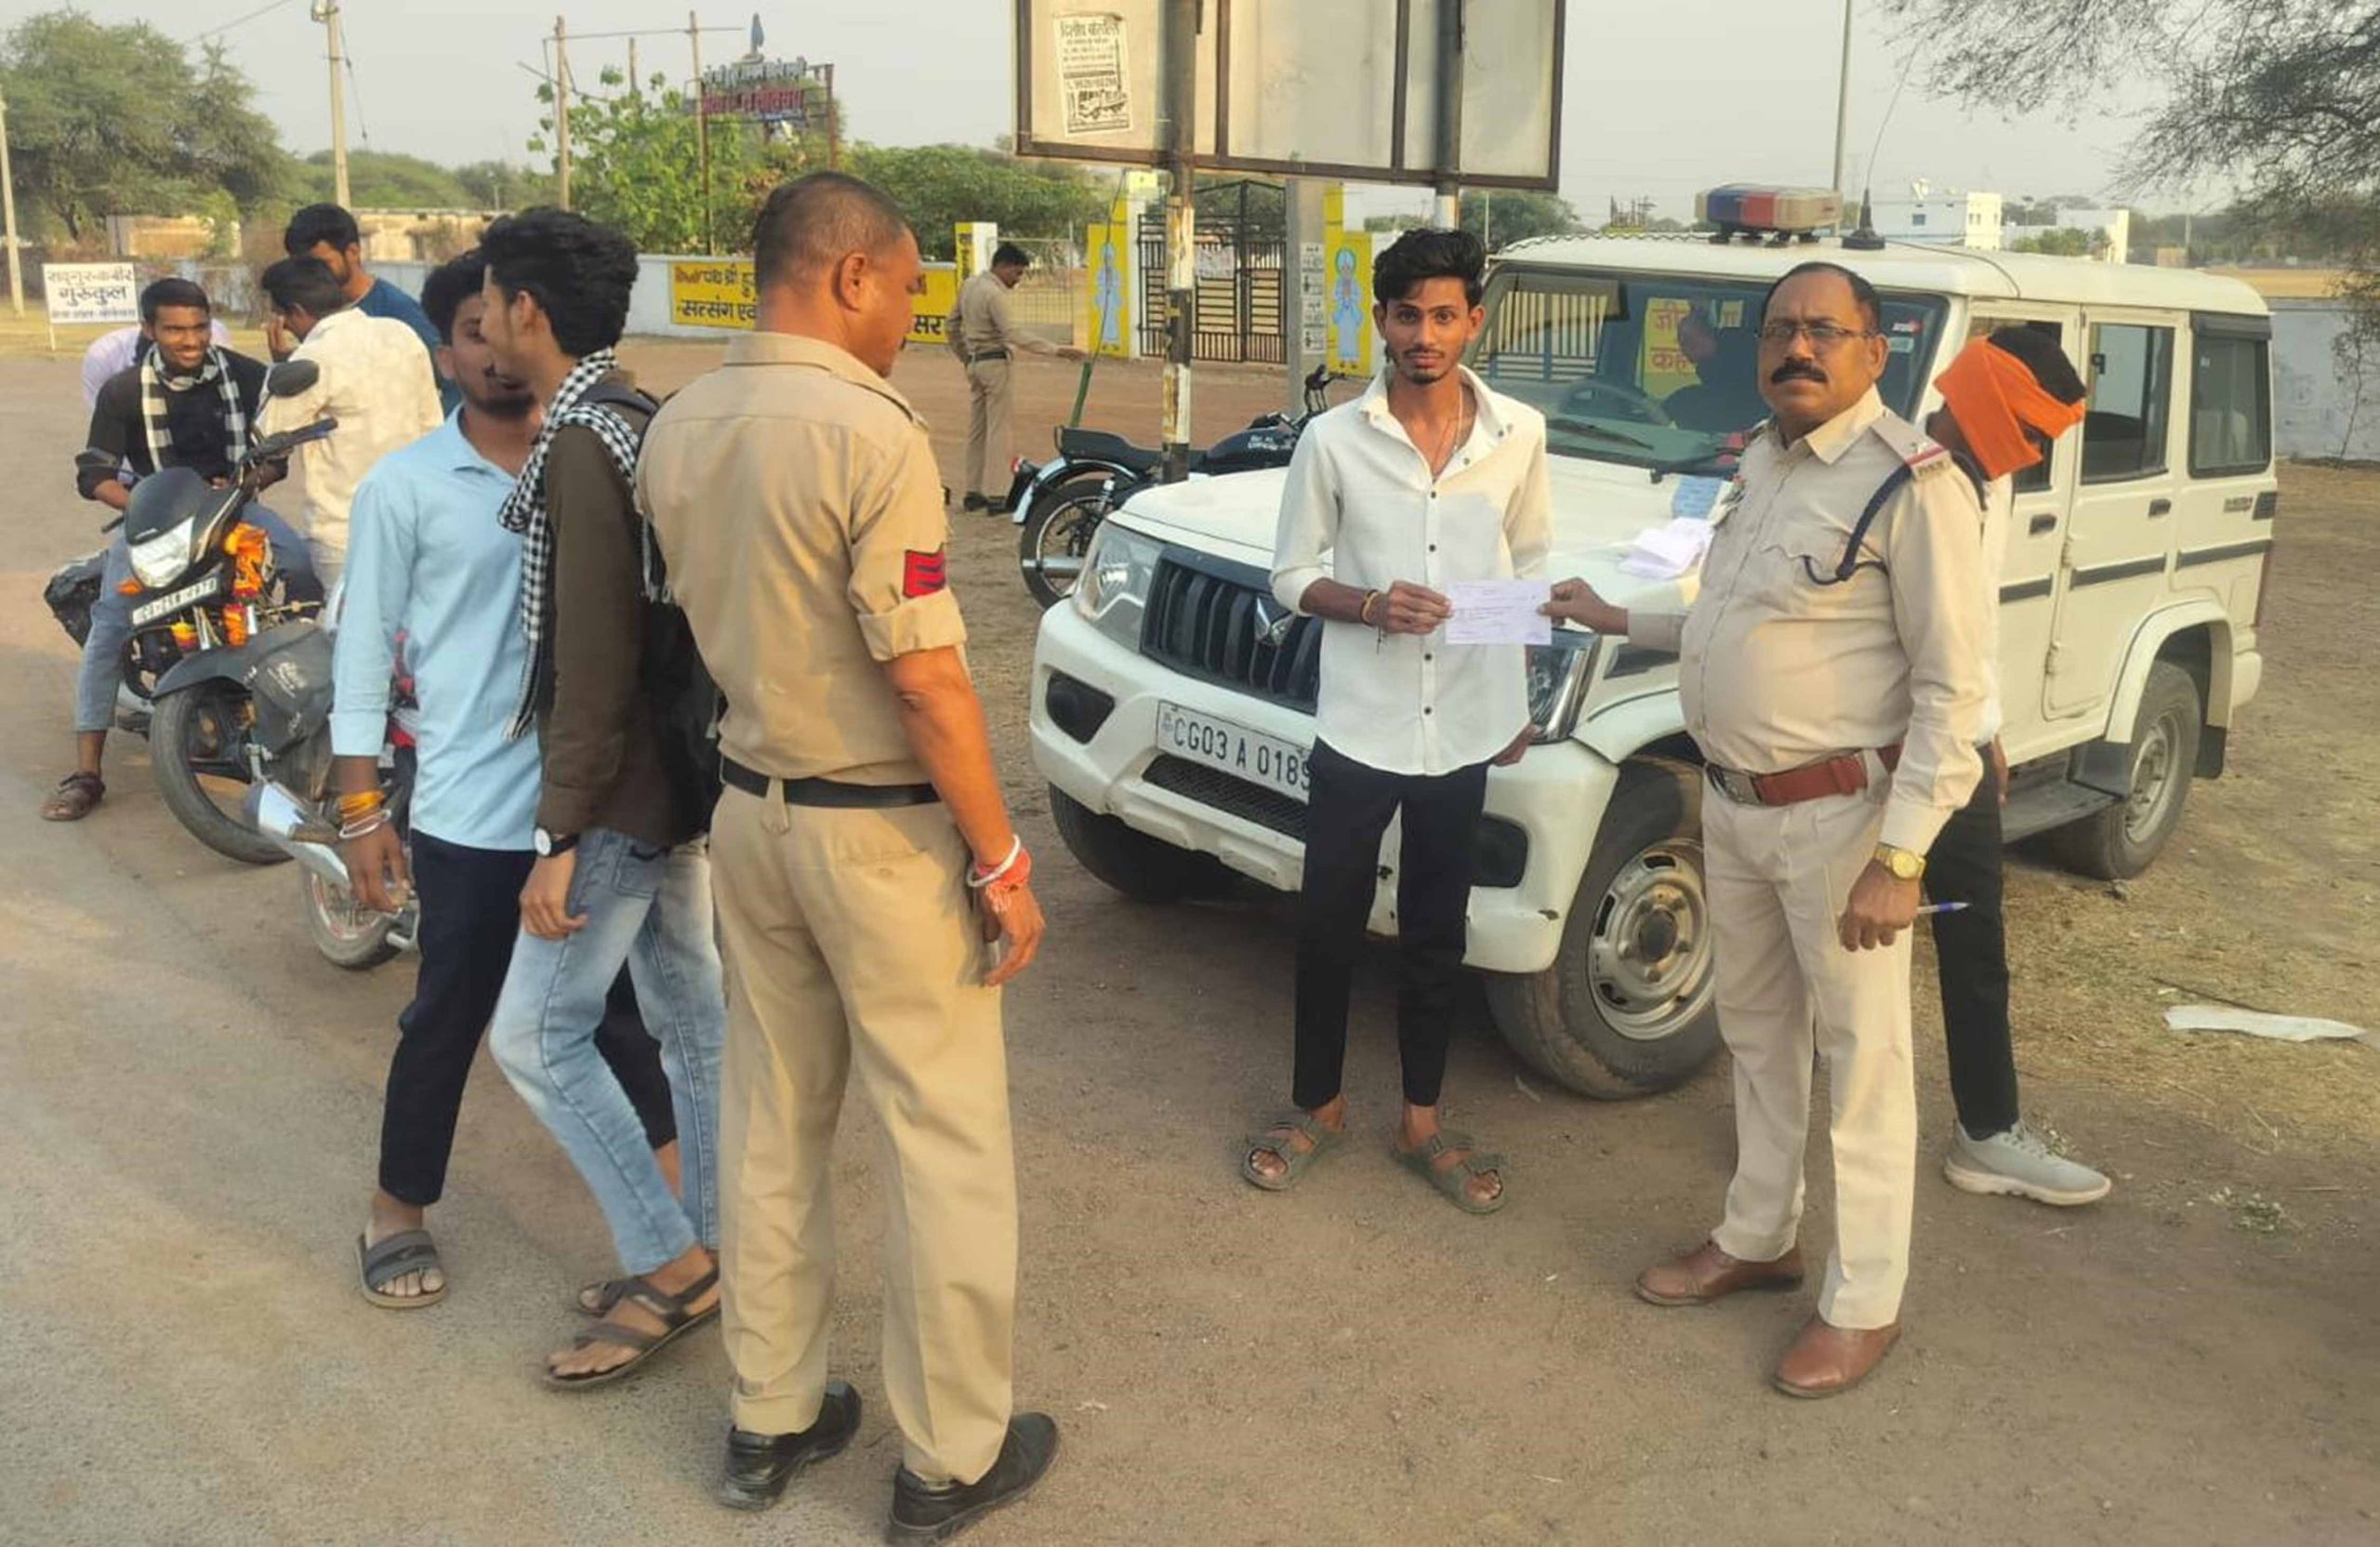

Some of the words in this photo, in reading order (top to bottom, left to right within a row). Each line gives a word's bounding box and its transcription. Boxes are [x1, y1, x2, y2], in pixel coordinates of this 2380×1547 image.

[681, 295, 734, 318] सत्संग
[914, 314, 946, 336] सर
[1173, 718, 1227, 760] CG03
[1236, 738, 1247, 769] A
